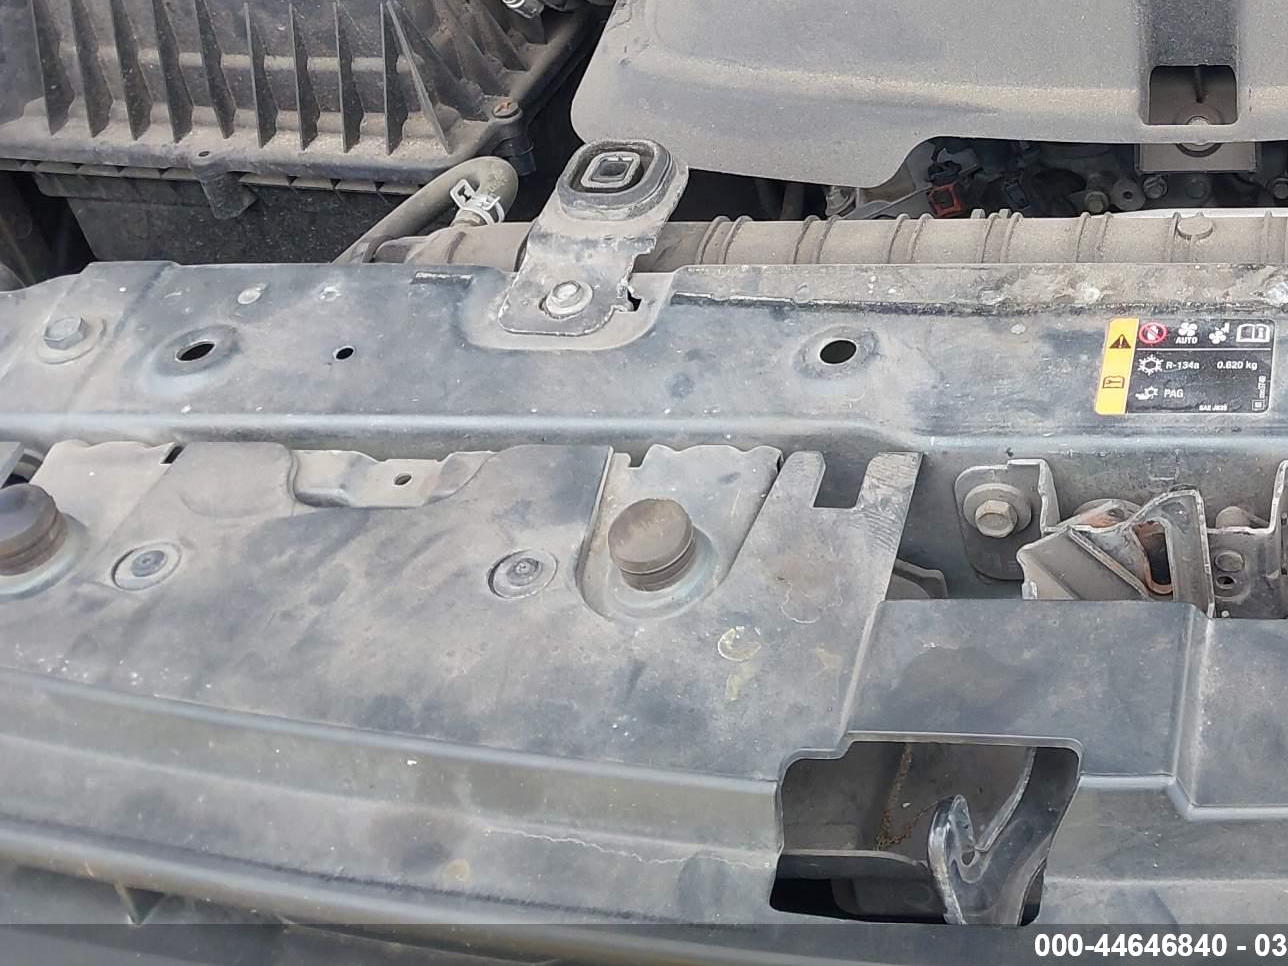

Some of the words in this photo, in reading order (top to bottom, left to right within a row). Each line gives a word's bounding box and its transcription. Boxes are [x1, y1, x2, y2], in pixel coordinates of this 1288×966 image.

[1175, 336, 1198, 344] AUTO
[1165, 361, 1200, 370] R-134a
[1245, 360, 1258, 371] kg
[1163, 389, 1184, 398] PAG
